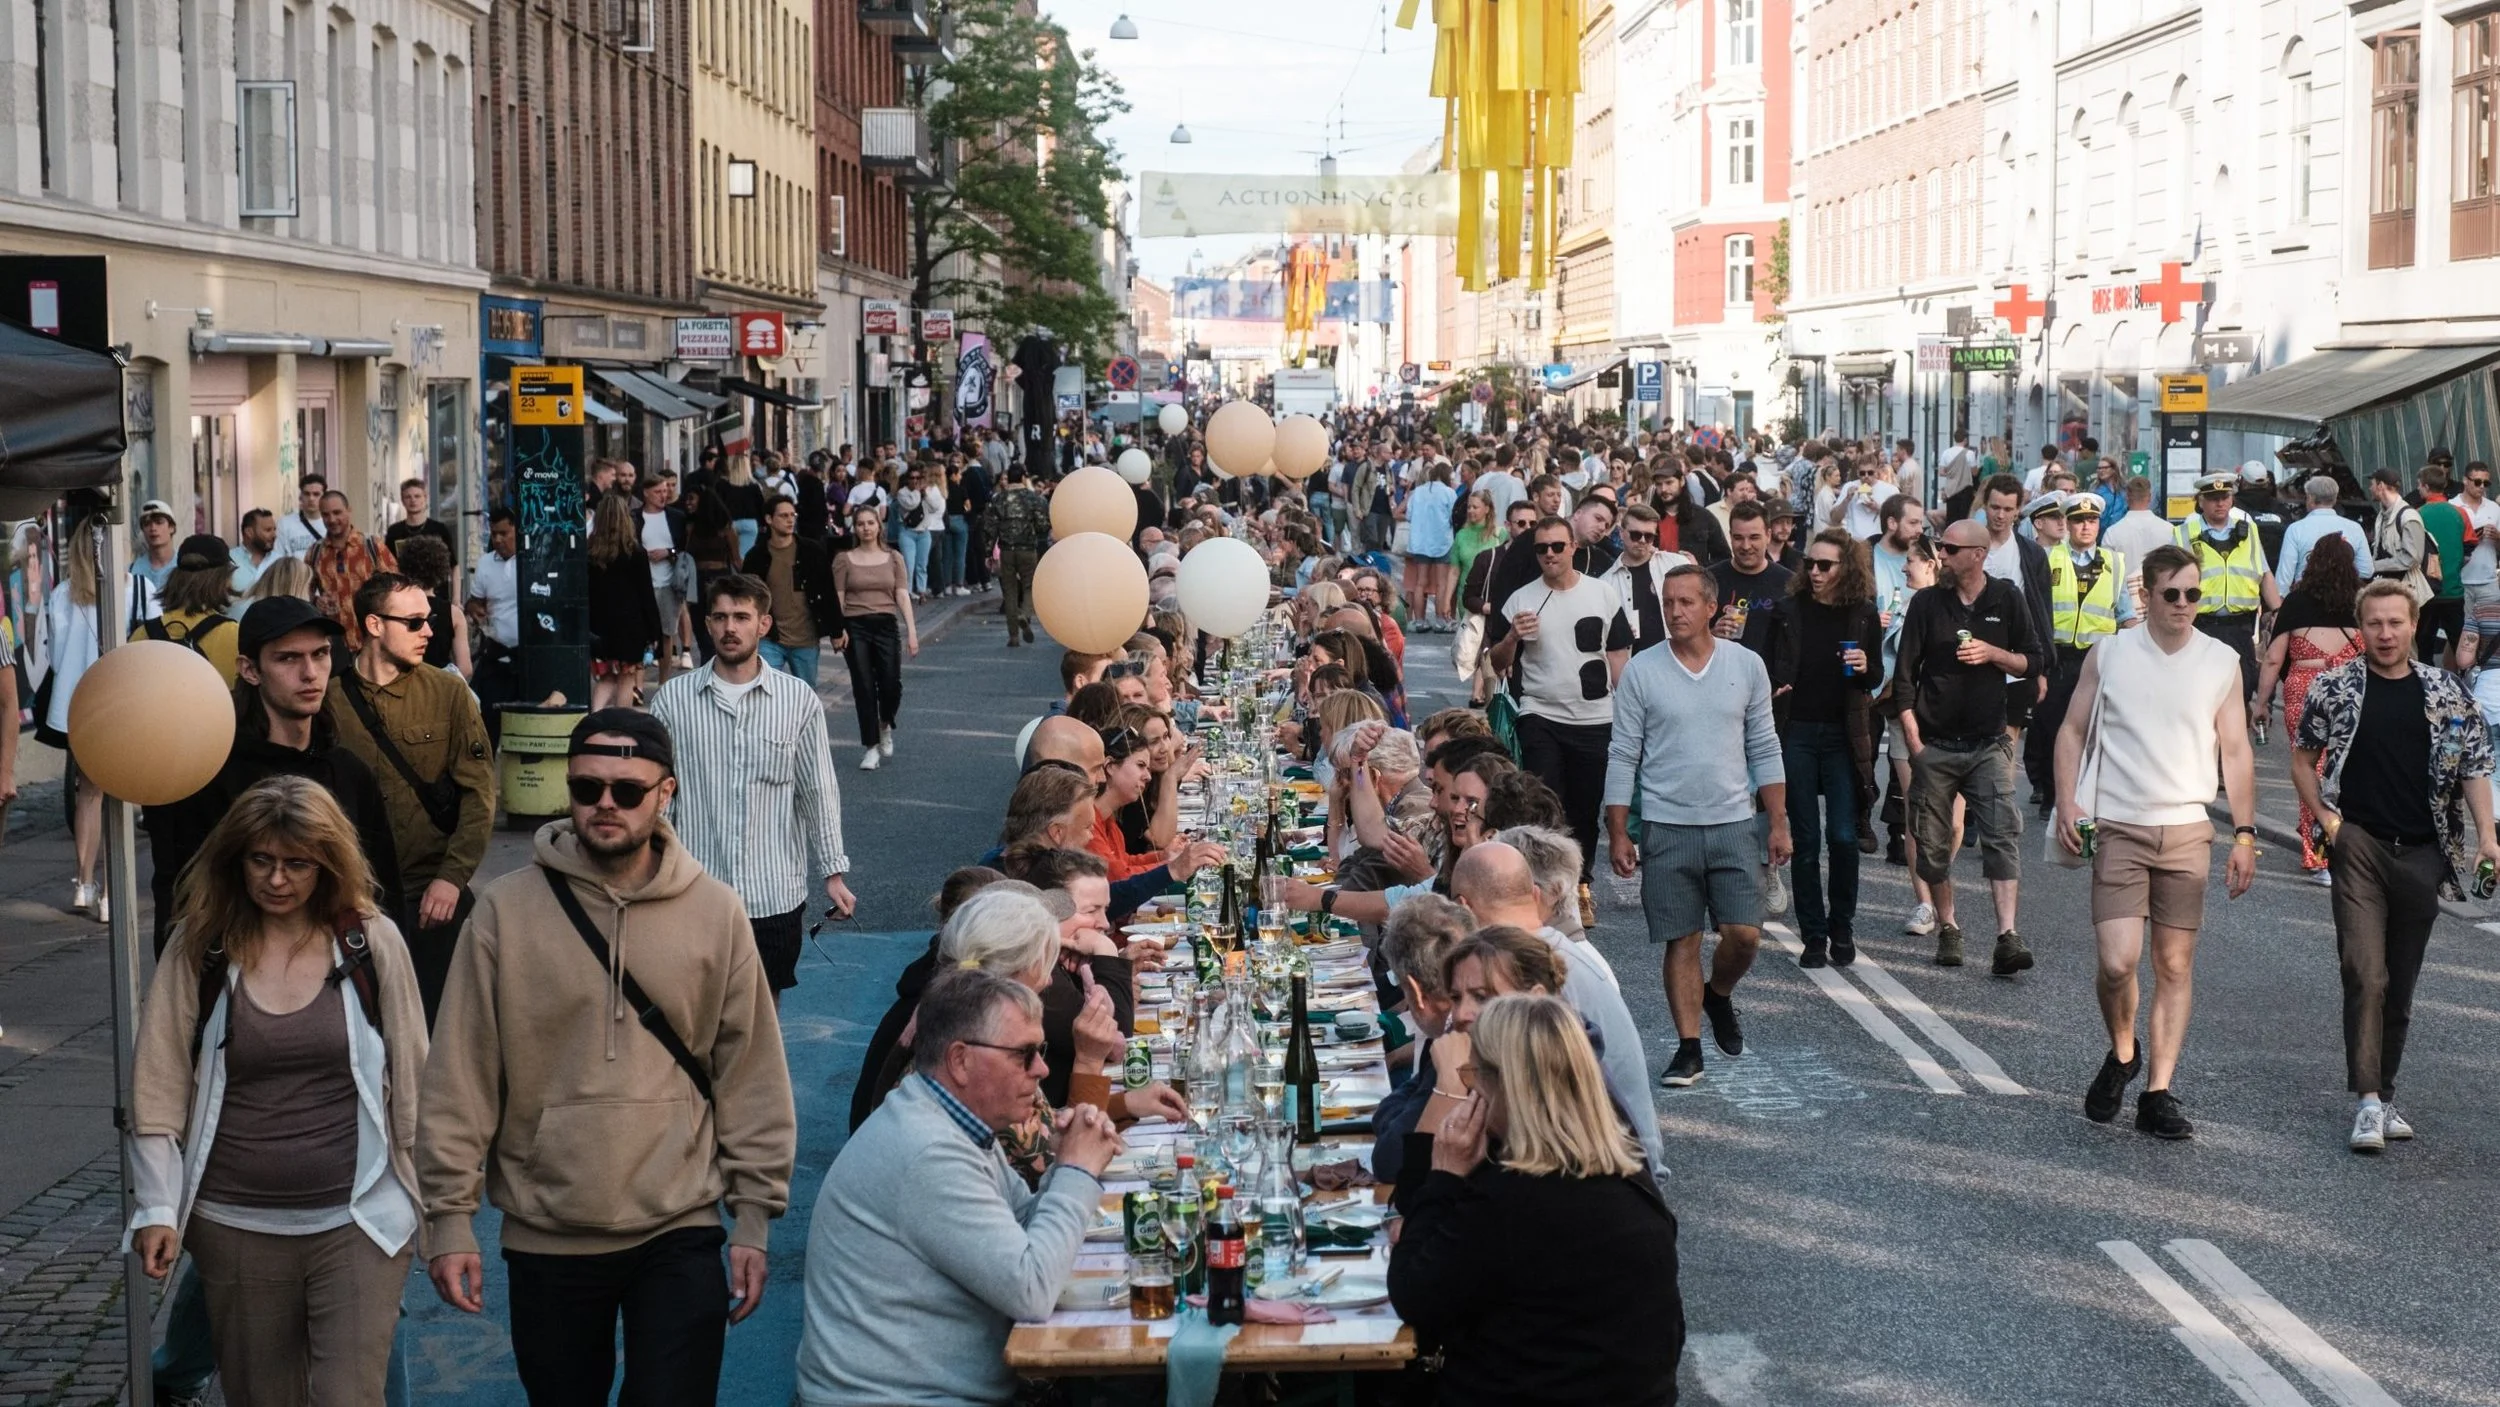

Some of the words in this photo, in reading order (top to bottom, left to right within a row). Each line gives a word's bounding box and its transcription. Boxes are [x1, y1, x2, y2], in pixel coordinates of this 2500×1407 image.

[678, 321, 688, 330] LA
[691, 320, 729, 330] FORETTA
[681, 334, 729, 343] PIZZERIA
[1920, 345, 1951, 358] CYKE
[1953, 348, 2016, 362] ANKARA
[1920, 360, 1951, 370] MAST
[1642, 364, 1657, 384] P
[521, 397, 535, 407] 23
[534, 471, 559, 479] movia
